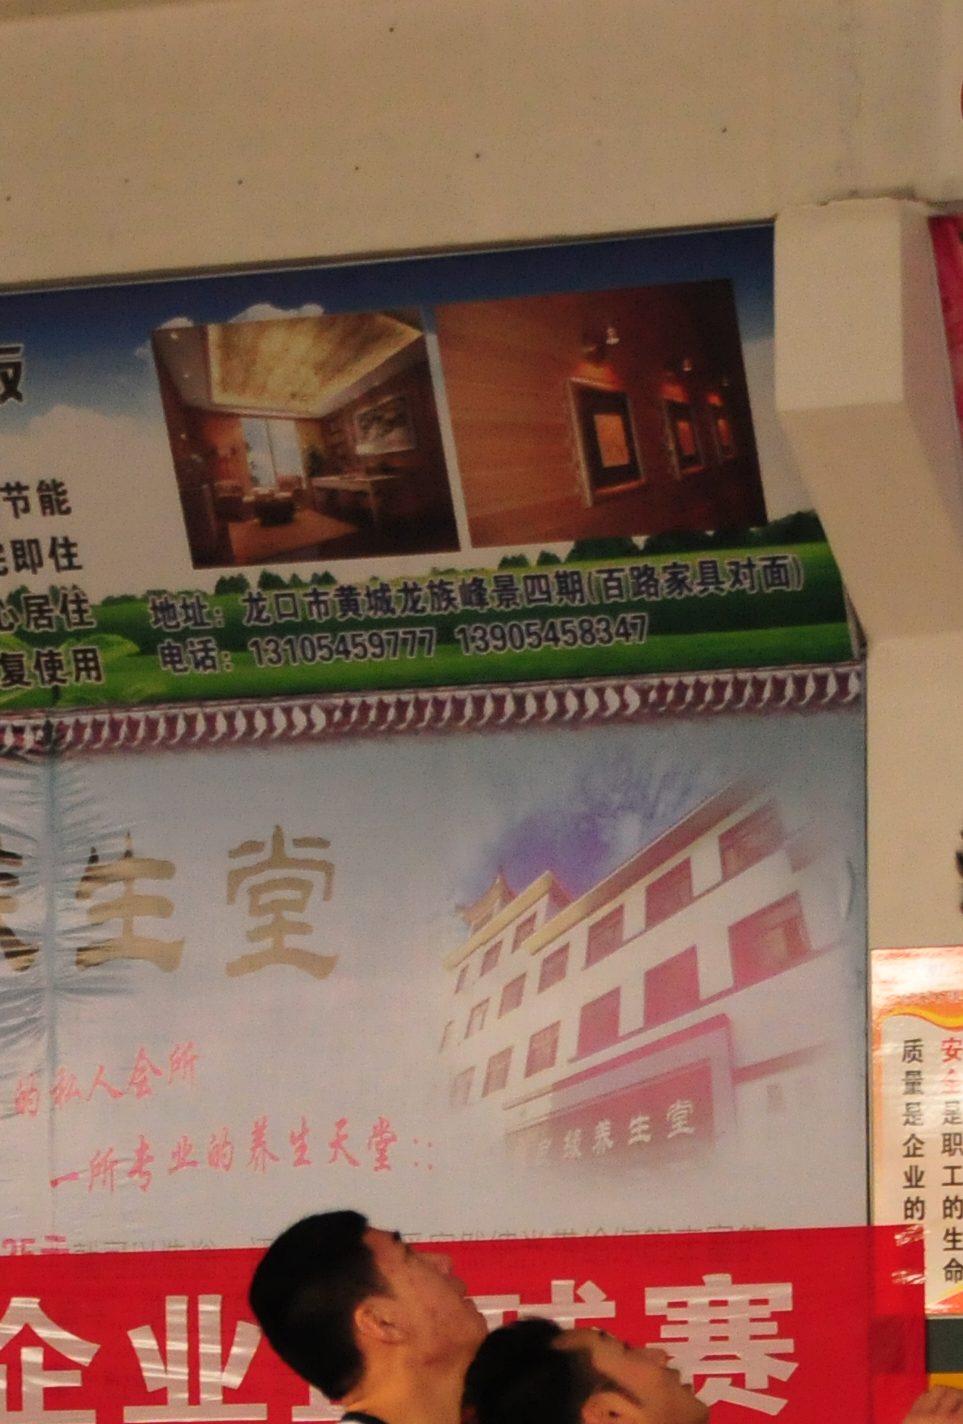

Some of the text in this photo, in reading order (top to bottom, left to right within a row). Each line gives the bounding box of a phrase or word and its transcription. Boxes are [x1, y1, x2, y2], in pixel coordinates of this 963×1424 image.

[0, 536, 82, 577] 即住
[454, 612, 649, 656] 13905458347
[901, 1037, 926, 1222] 质量是企业的
